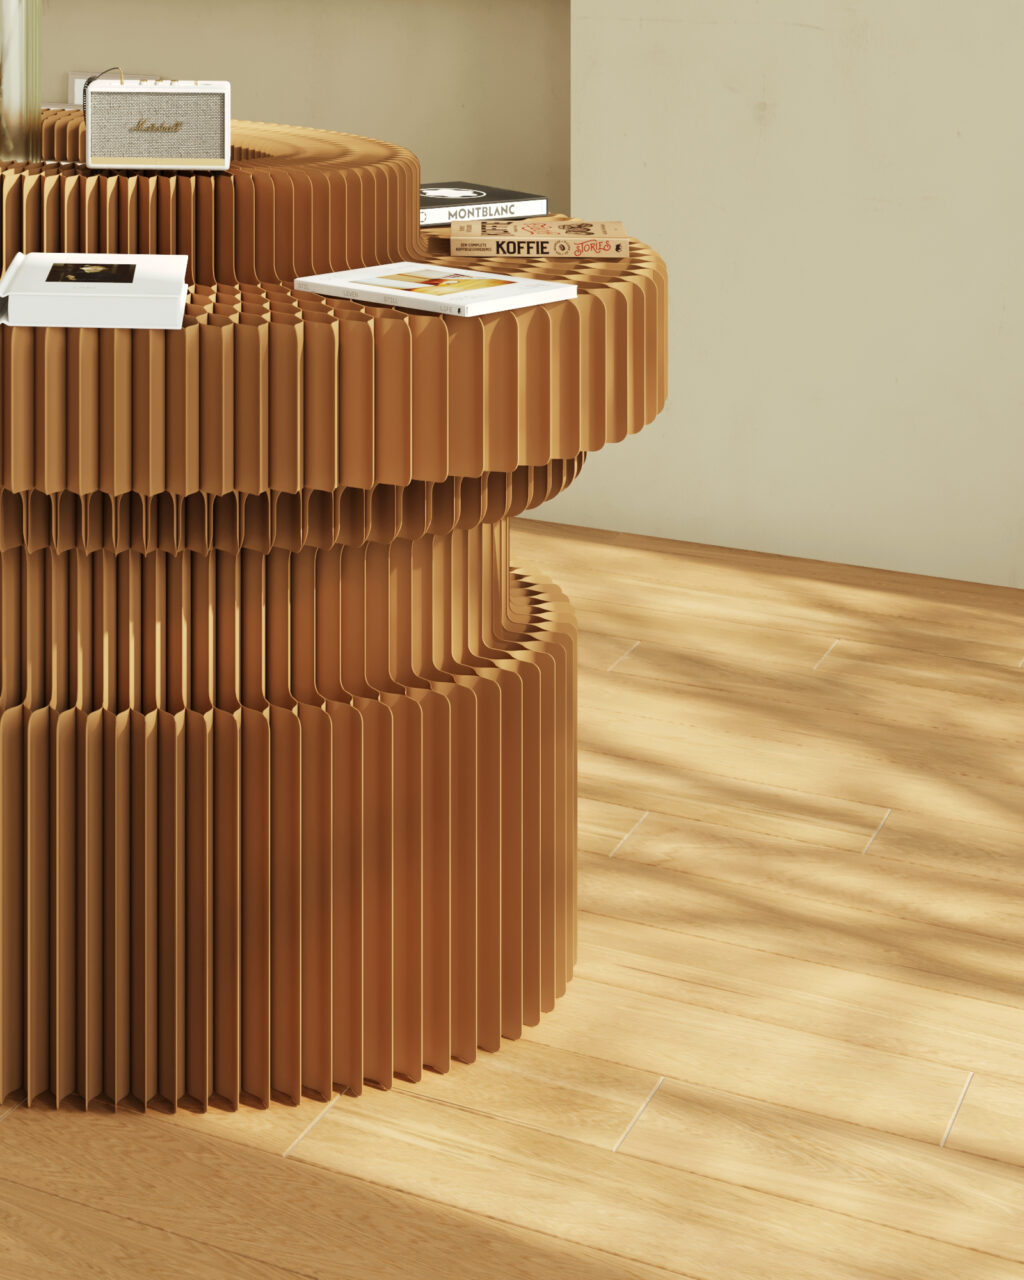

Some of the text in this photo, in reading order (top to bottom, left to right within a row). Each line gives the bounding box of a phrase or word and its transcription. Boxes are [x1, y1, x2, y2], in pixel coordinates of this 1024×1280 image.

[448, 204, 515, 220] MONTBLANC
[495, 241, 550, 255] KOFFIE
[574, 239, 612, 257] STORIES
